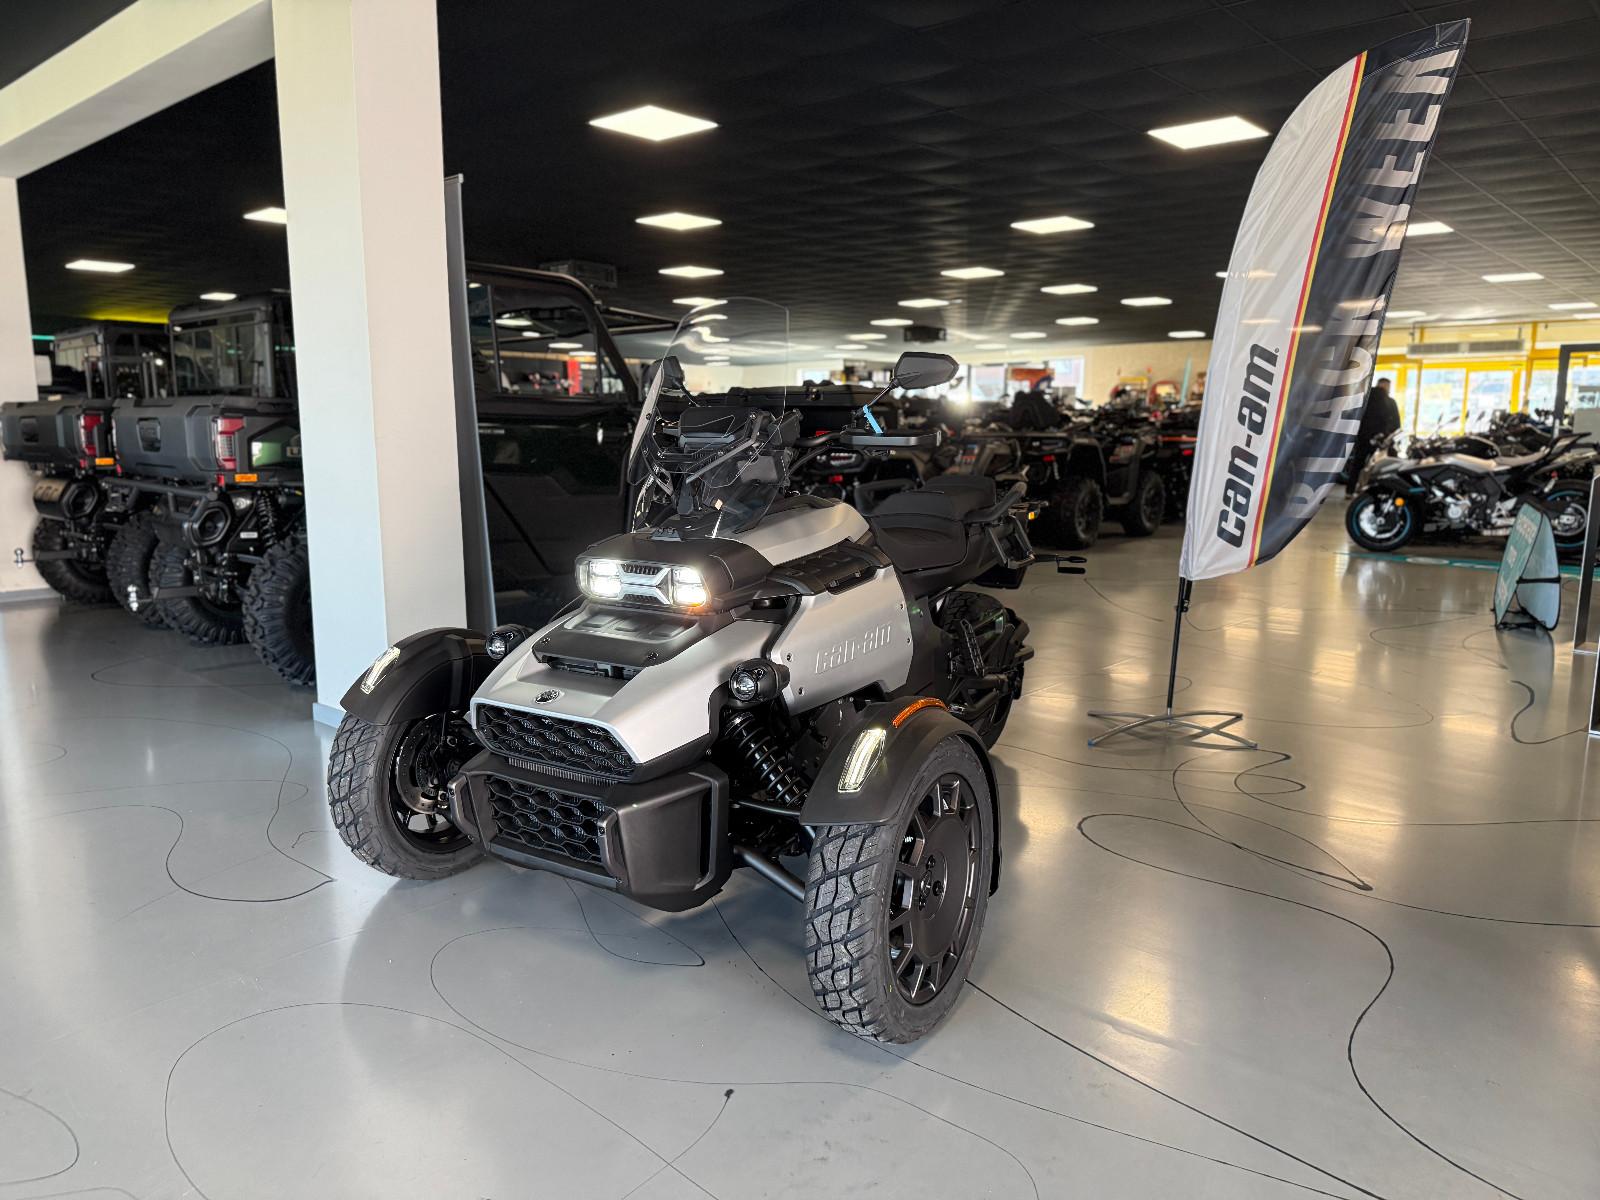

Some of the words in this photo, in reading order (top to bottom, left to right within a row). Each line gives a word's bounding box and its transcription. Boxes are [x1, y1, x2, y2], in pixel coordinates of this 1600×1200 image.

[1286, 292, 1384, 519] BLACK
[1342, 49, 1460, 258] WEEK
[1216, 343, 1279, 548] can-am
[815, 623, 891, 674] can-am
